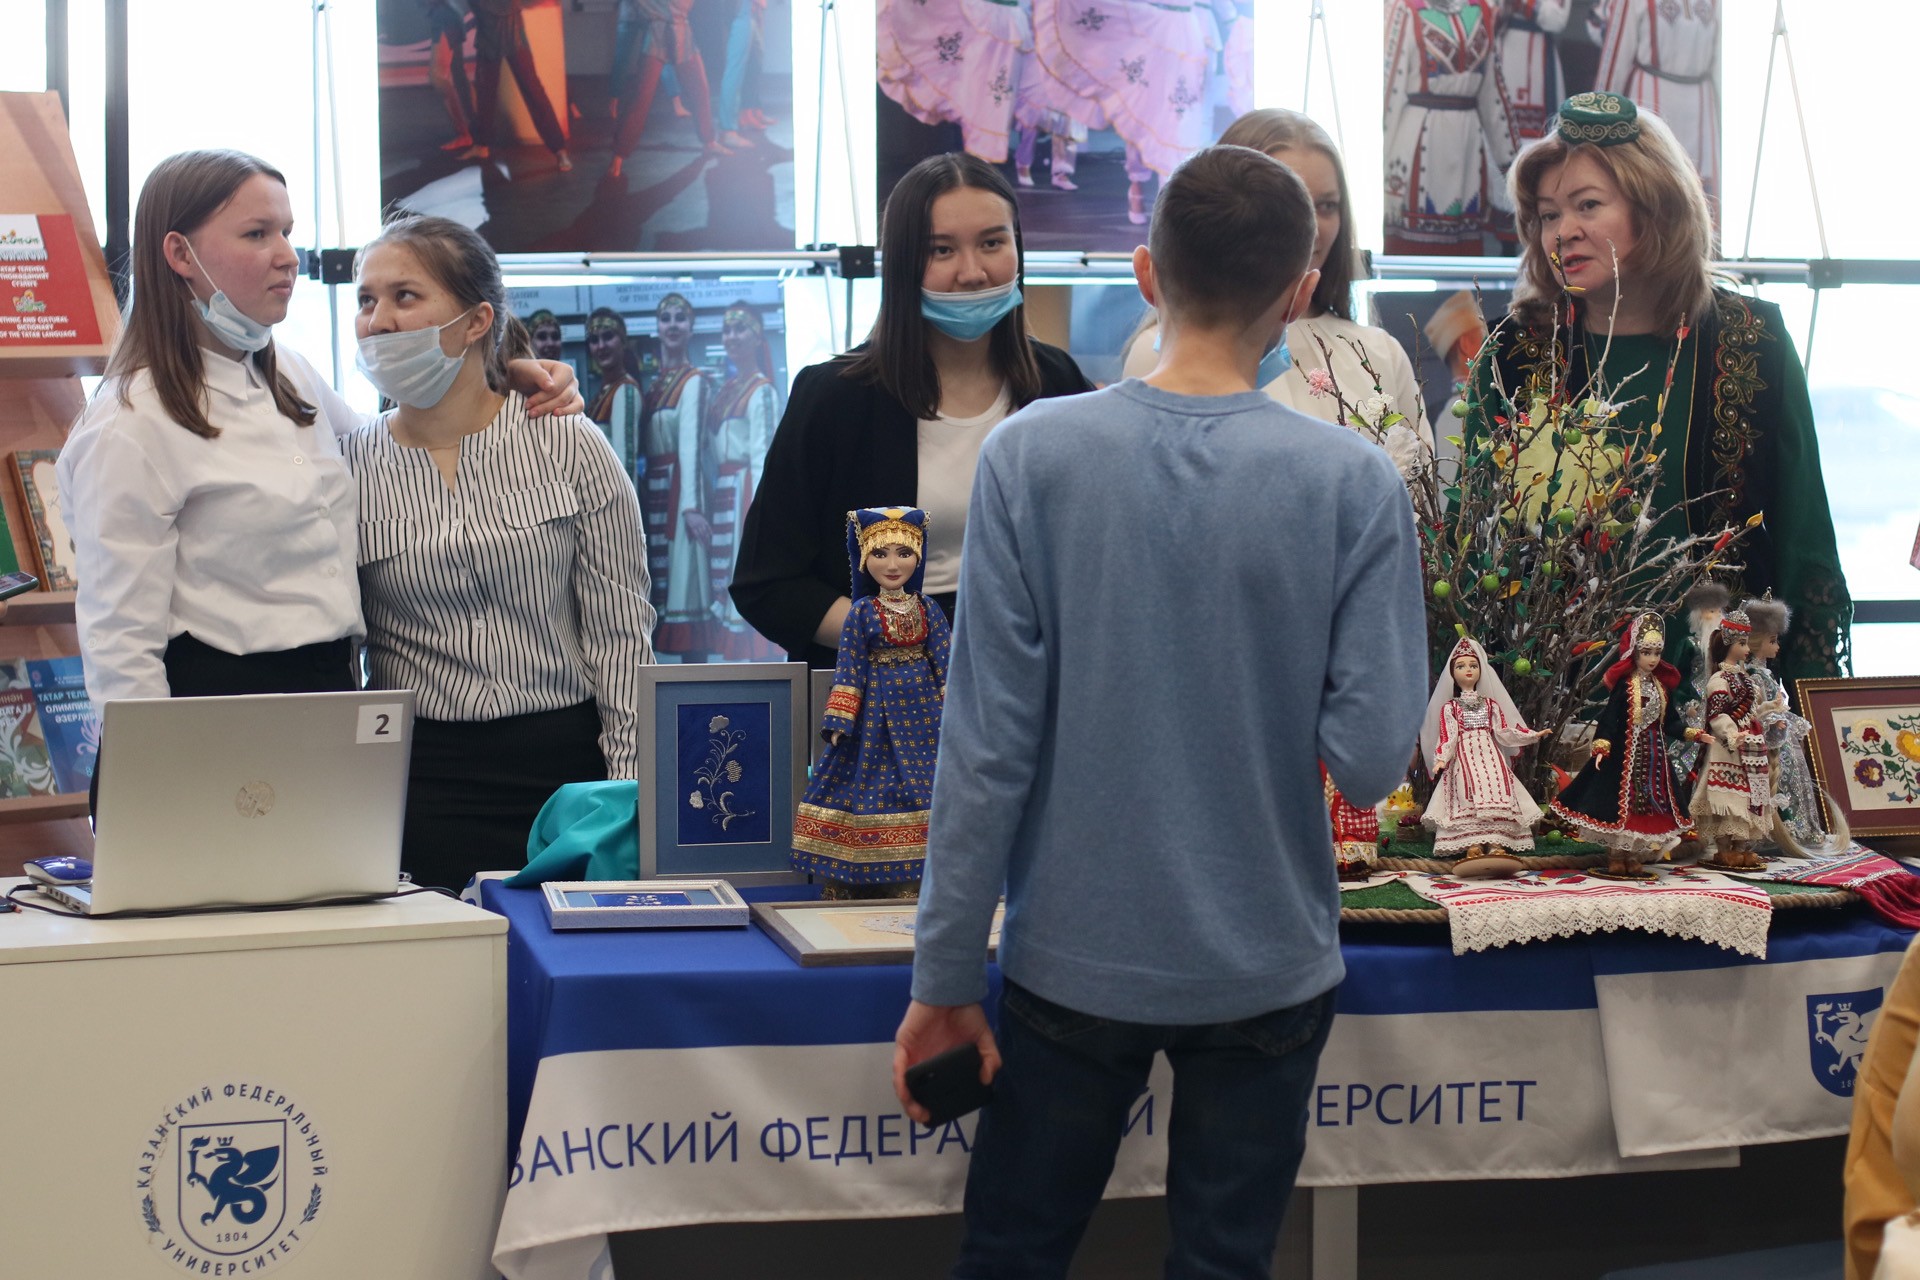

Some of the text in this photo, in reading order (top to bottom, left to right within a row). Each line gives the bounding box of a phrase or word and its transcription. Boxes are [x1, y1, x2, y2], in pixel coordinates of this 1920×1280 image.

[41, 330, 77, 338] LANGUAGE
[37, 691, 64, 702] ТАТАР
[375, 713, 390, 735] 2
[1310, 1080, 1538, 1128] ЕРСИТЕТ
[137, 1083, 328, 1188] КАЗАНСКИЙ ФЕДЕРАЛЬНЫЙ
[216, 1231, 248, 1243] 1804
[162, 1229, 300, 1276] УНИВЕРСИТЕТ
